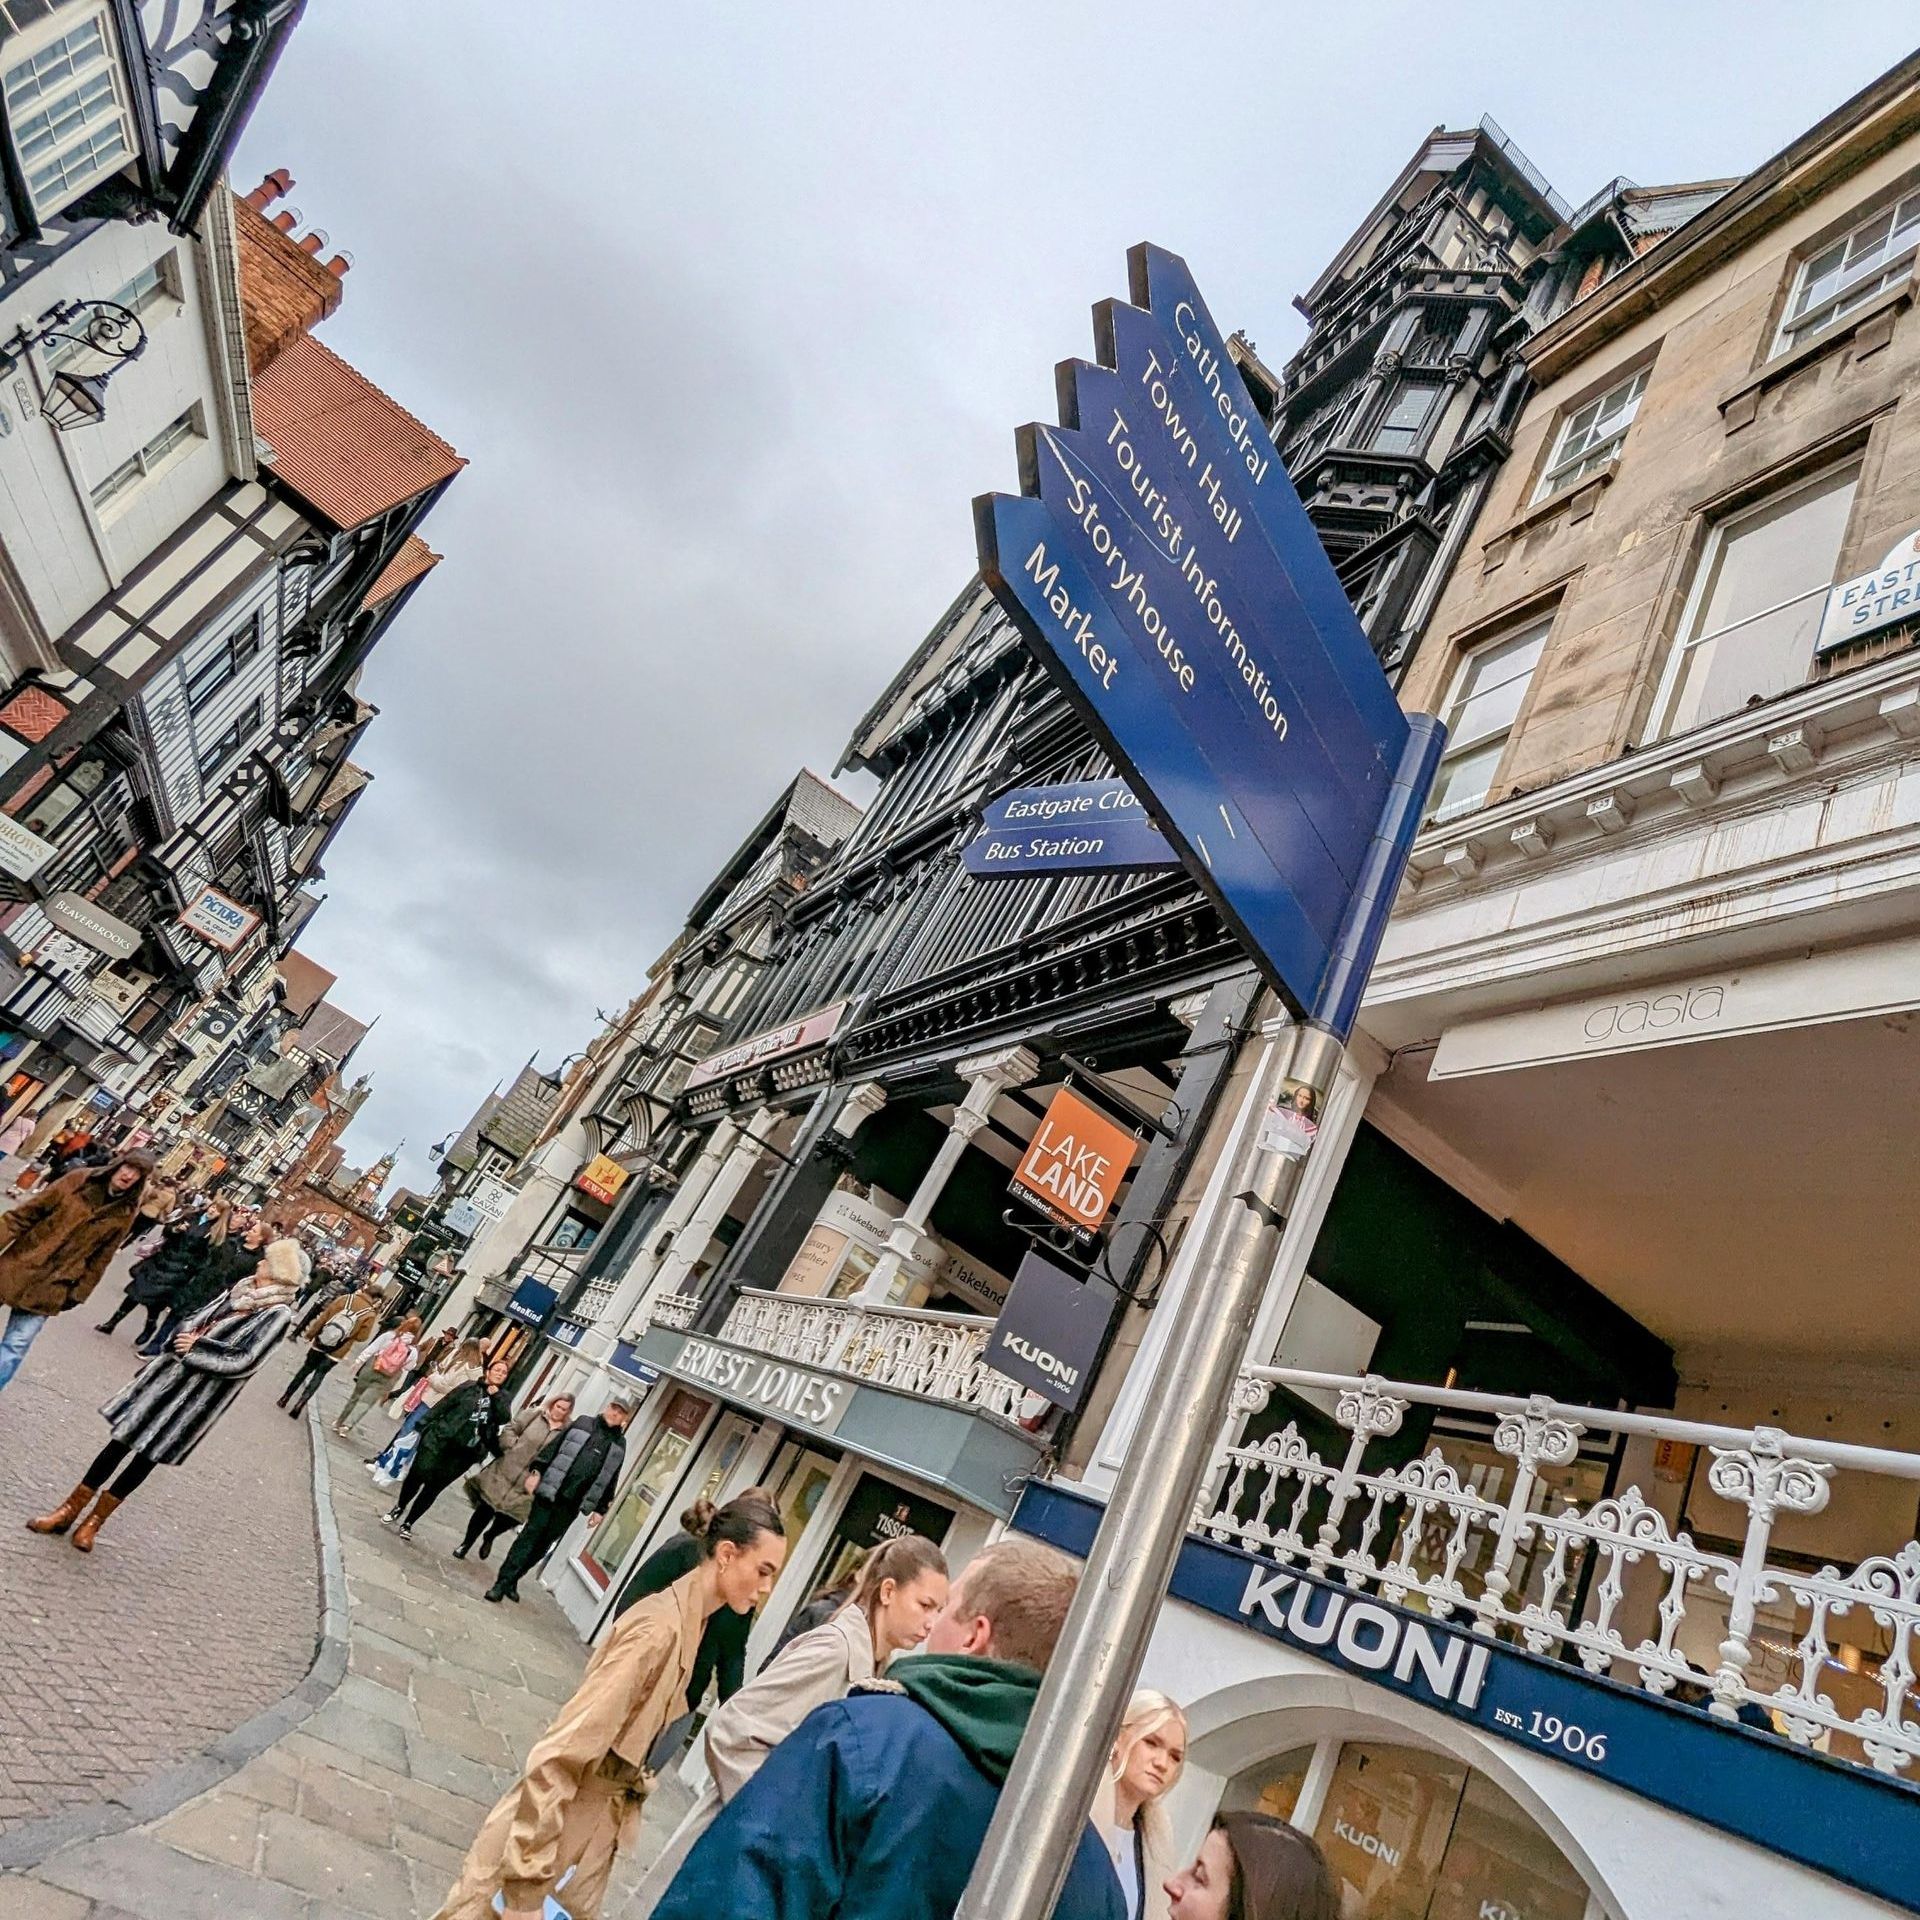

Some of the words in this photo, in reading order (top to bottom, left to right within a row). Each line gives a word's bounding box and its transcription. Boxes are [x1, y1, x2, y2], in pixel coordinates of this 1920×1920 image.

[1174, 301, 1270, 484] Cathedral
[1142, 349, 1200, 468] Town
[1200, 463, 1243, 544] Hall
[1067, 478, 1197, 692] Storyhouse
[1107, 408, 1182, 556] Tourist
[1181, 546, 1291, 743] Information
[1024, 543, 1119, 691] Market
[1004, 795, 1093, 820] Eastgate
[984, 843, 1021, 860] Bus
[1025, 838, 1104, 858] Station
[55, 900, 132, 950] BEAVERBROOKS
[1584, 986, 1724, 1043] gasia
[1024, 1147, 1104, 1218] LAND
[1038, 1121, 1111, 1188] LAKE
[473, 1196, 504, 1218] CAVANI
[584, 1180, 608, 1199] EWM
[676, 1340, 755, 1392] ERNEST
[747, 1363, 843, 1424] JONES
[1002, 1331, 1079, 1386] KUONI
[1053, 1380, 1070, 1394] 1906
[1238, 1564, 1492, 1709] KUONI
[1495, 1707, 1524, 1731] EST.
[1527, 1711, 1608, 1762] 1906
[1333, 1818, 1400, 1867] KUONI
